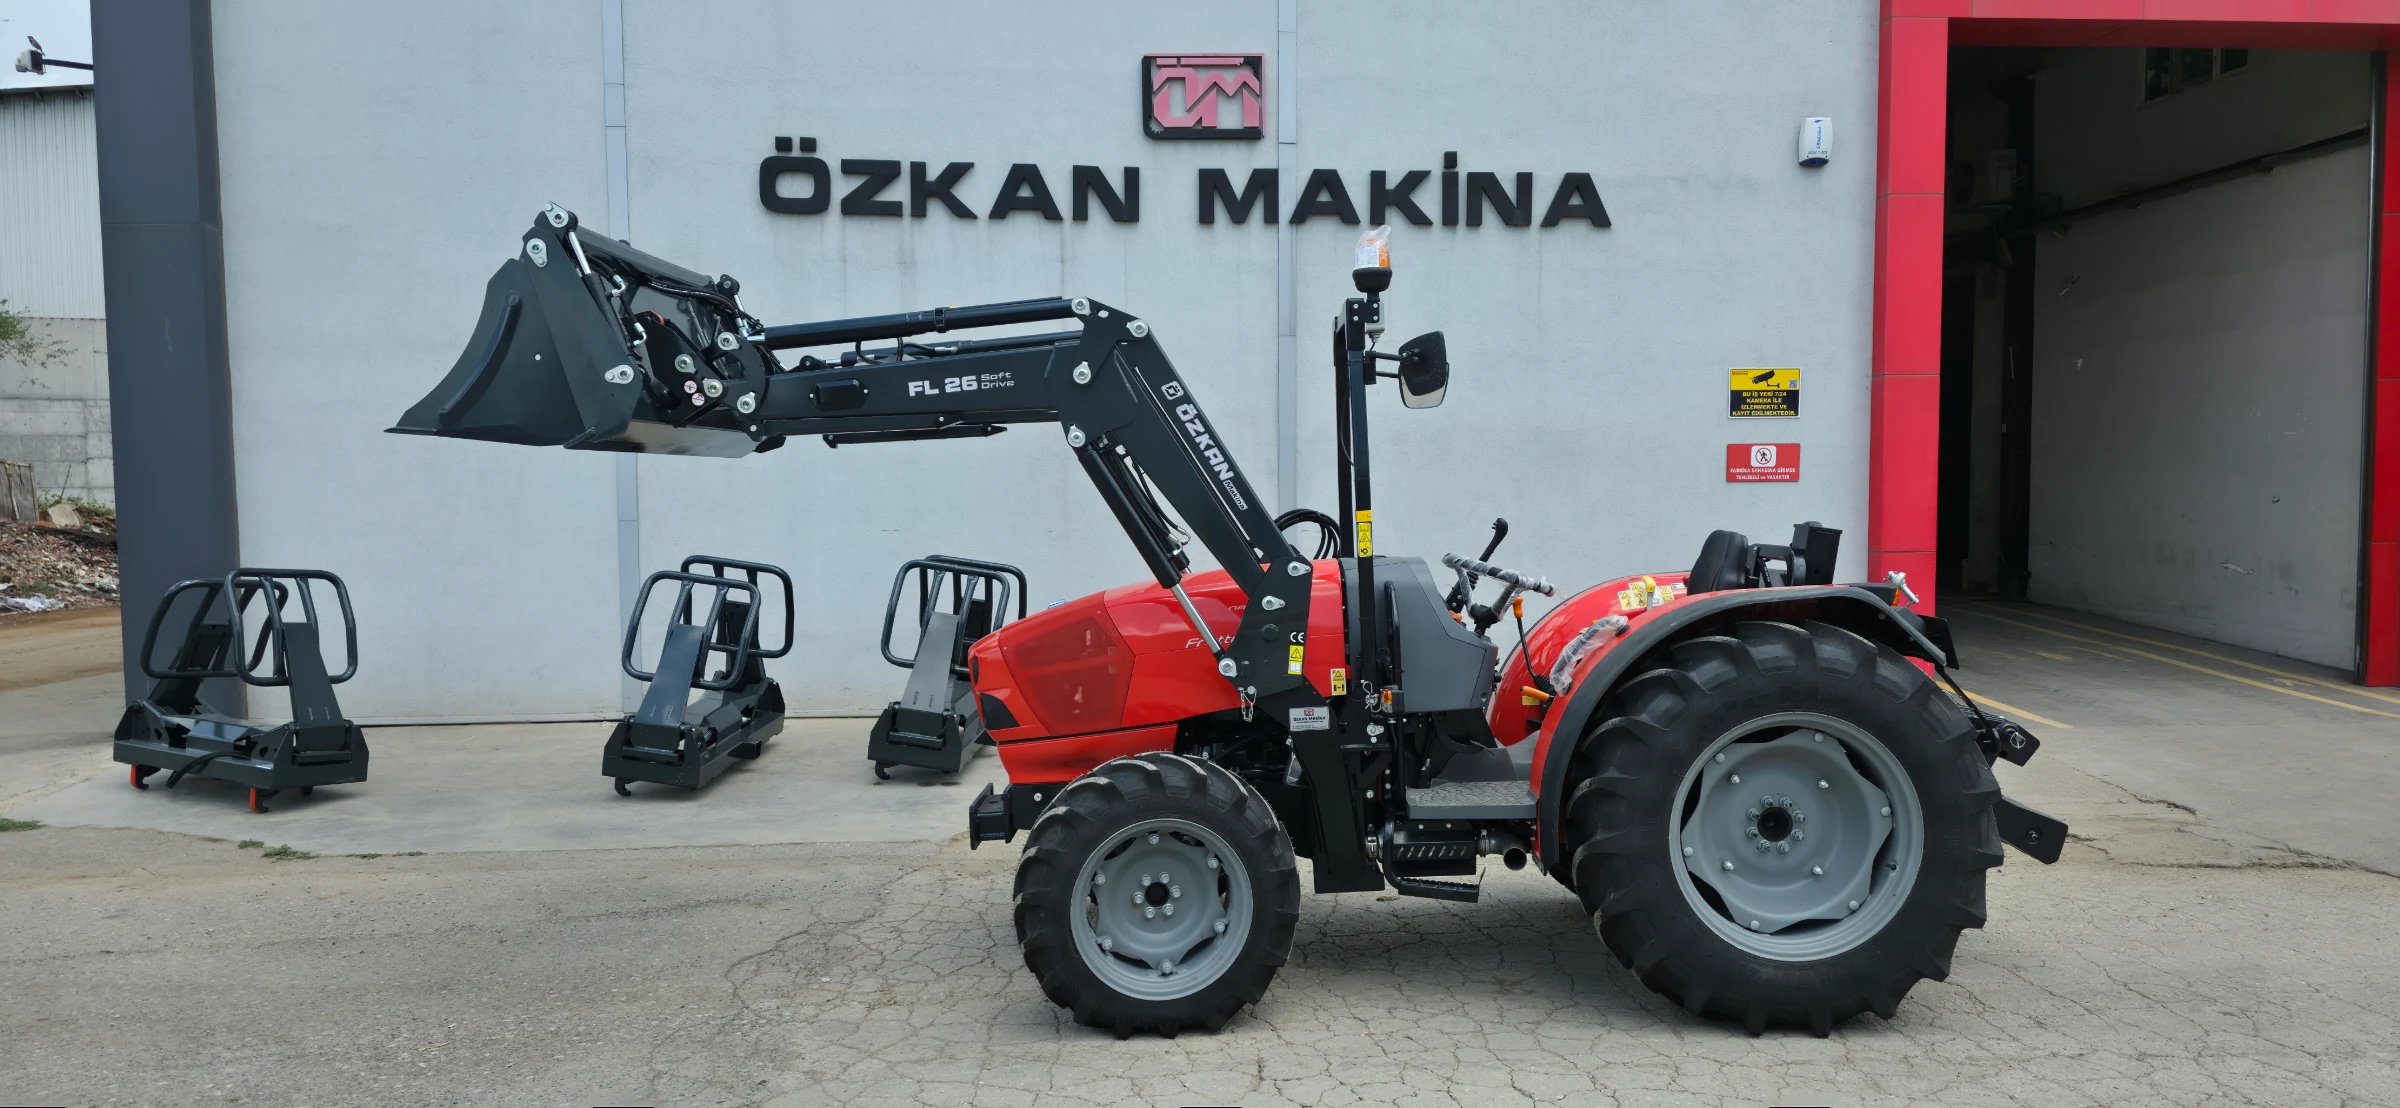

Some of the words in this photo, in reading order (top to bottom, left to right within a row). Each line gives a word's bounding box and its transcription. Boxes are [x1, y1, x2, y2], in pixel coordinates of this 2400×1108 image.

[759, 136, 1139, 221] ÖZKAN
[1199, 151, 1612, 226] MAKİNA
[981, 372, 1012, 381] Soft
[981, 380, 1015, 389] Drive
[908, 380, 939, 396] FL
[944, 375, 978, 393] 26
[1175, 403, 1235, 481] ÖZKAN
[1223, 480, 1248, 510] Makina
[1290, 632, 1305, 643] CE
